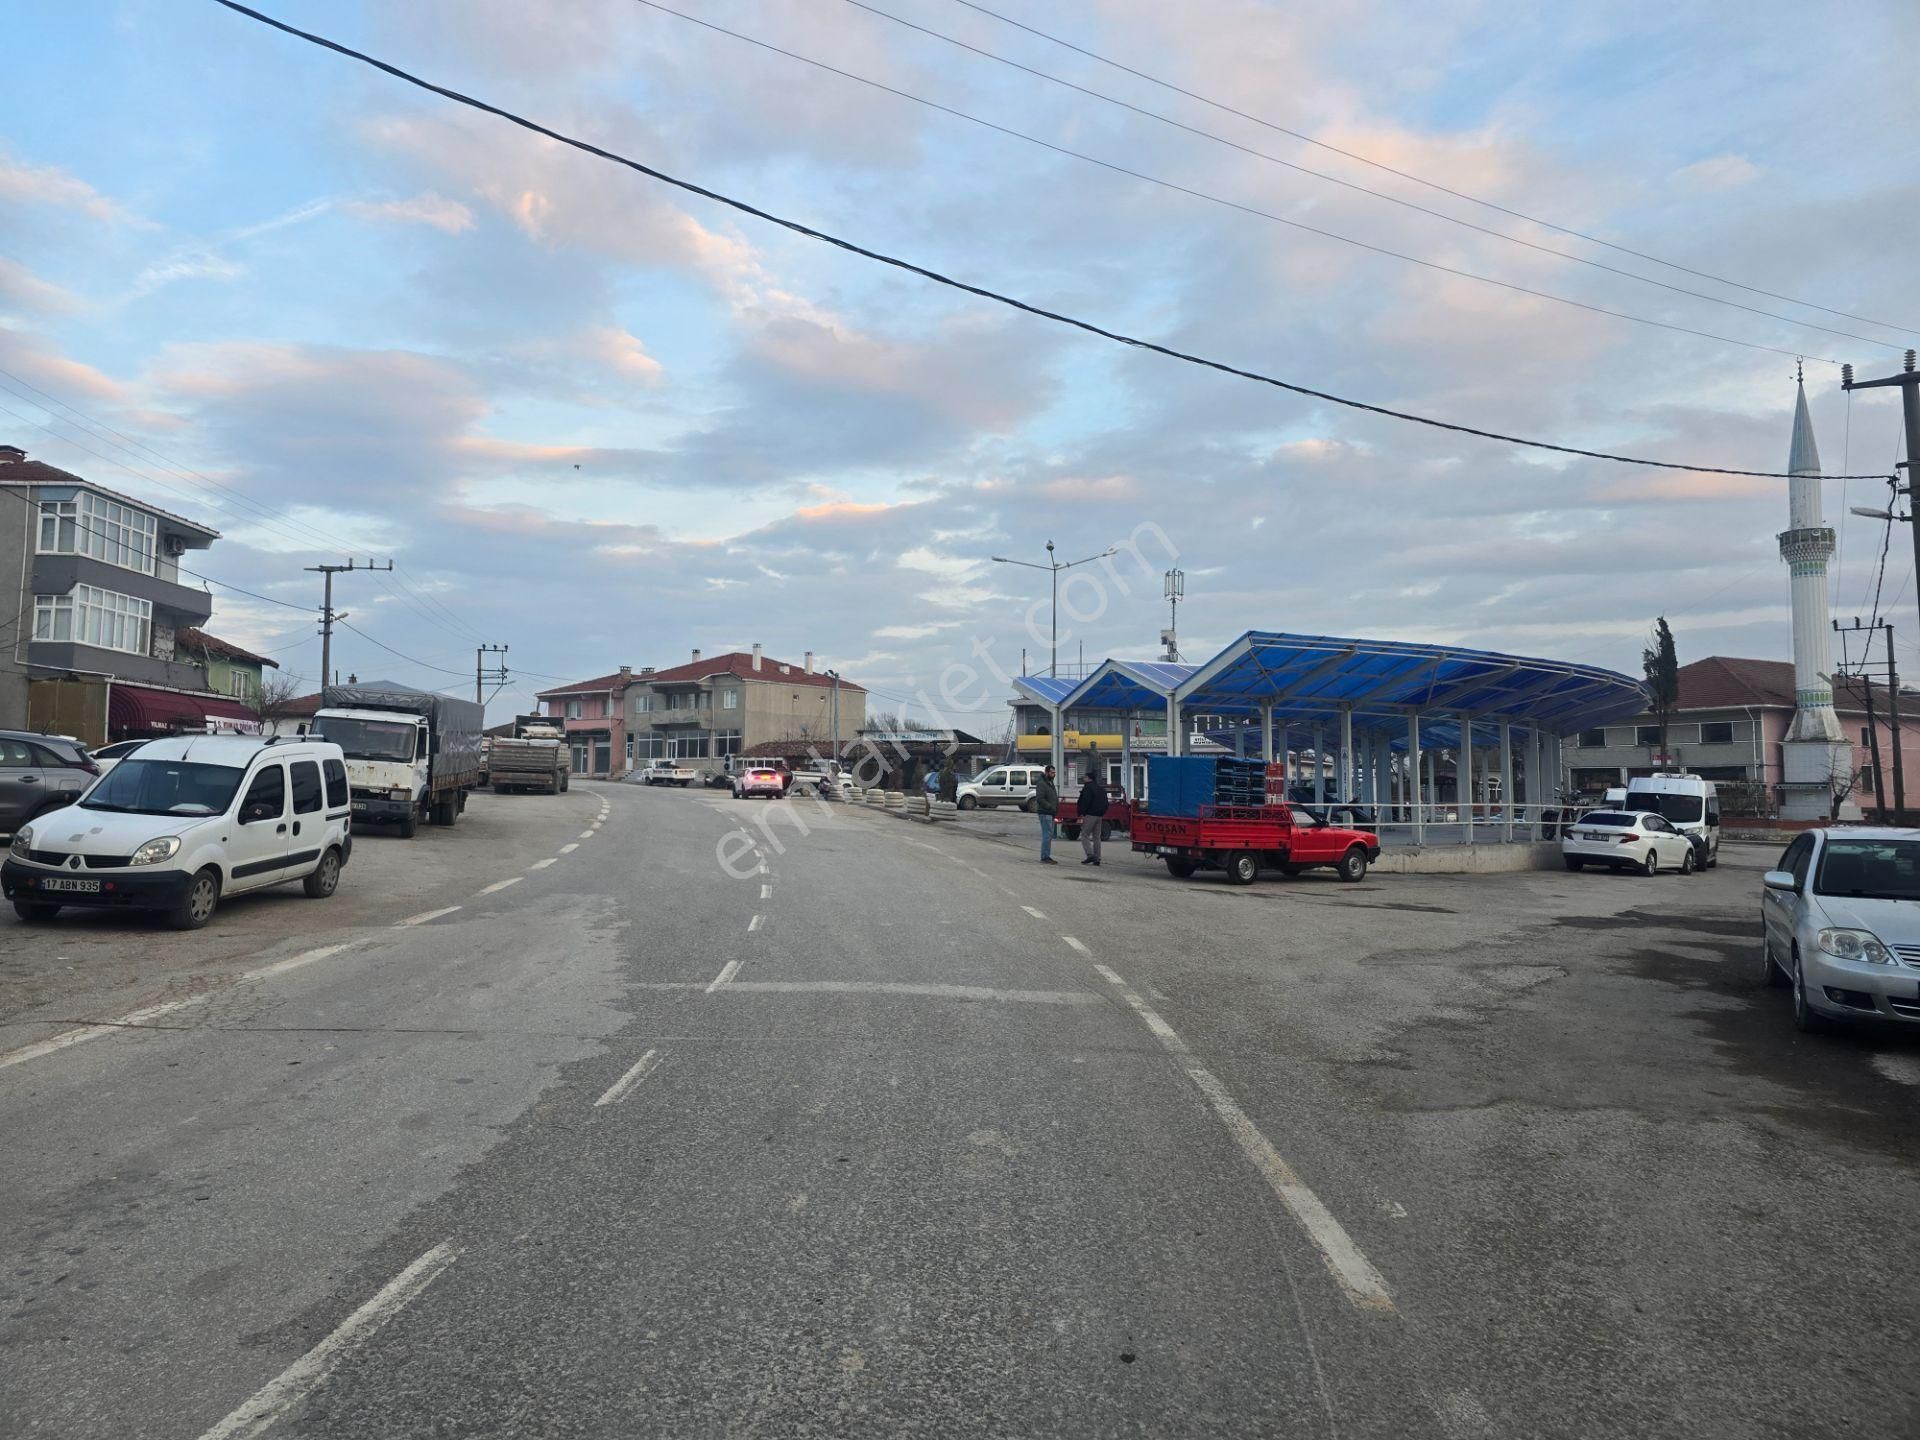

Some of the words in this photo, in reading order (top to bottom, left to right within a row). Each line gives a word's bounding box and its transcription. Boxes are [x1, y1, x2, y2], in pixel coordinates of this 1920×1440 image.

[1145, 822, 1186, 834] OTOSAN
[46, 880, 57, 888] 17
[60, 880, 78, 890] ABN
[80, 881, 99, 891] 935
